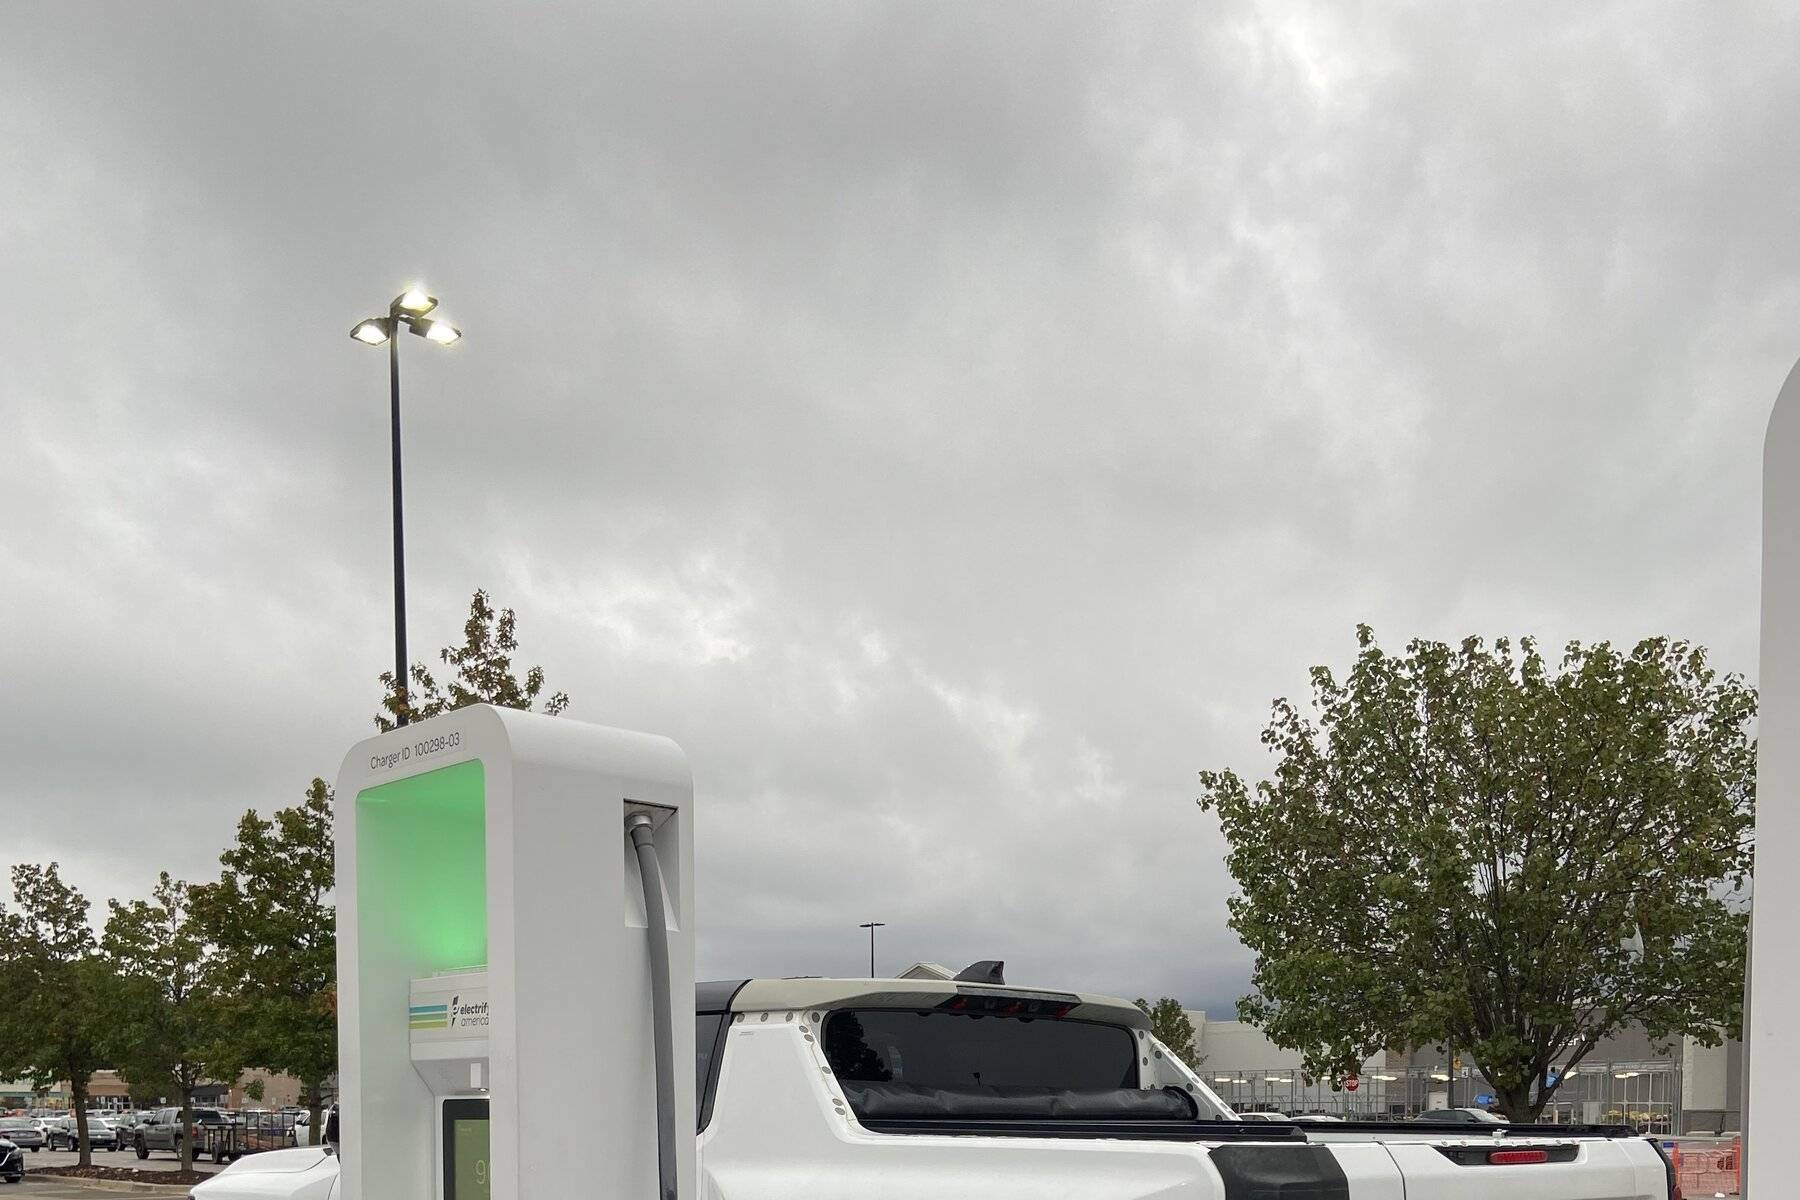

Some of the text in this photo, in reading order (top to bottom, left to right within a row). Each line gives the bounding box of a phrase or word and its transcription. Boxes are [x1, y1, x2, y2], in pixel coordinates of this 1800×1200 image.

[370, 732, 460, 769] Charger ID 100298-03
